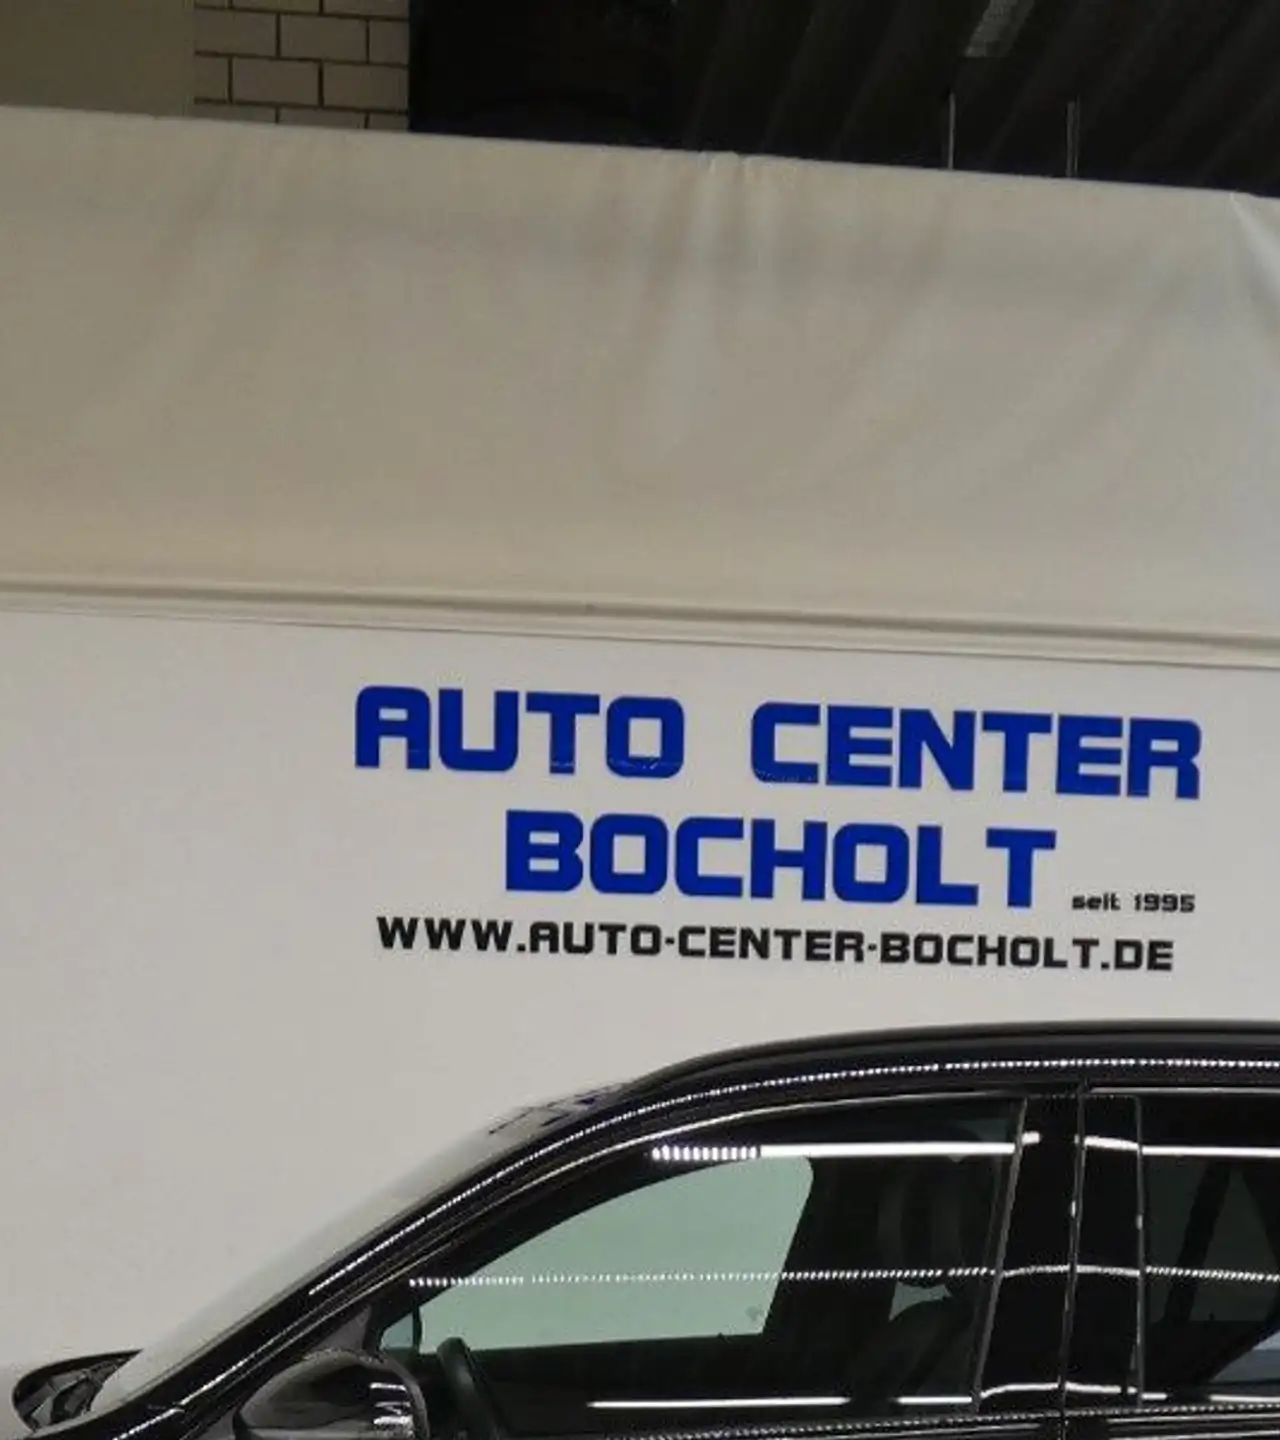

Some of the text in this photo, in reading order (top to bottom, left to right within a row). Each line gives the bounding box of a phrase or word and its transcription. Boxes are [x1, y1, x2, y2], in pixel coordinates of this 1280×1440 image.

[355, 685, 1202, 801] AUTO CENTER
[505, 808, 1057, 911] BOCHOLT
[1071, 892, 1196, 913] seit 1995
[376, 916, 1175, 972] WWW.AUTO-CENTER-BOCHOLT.DE
